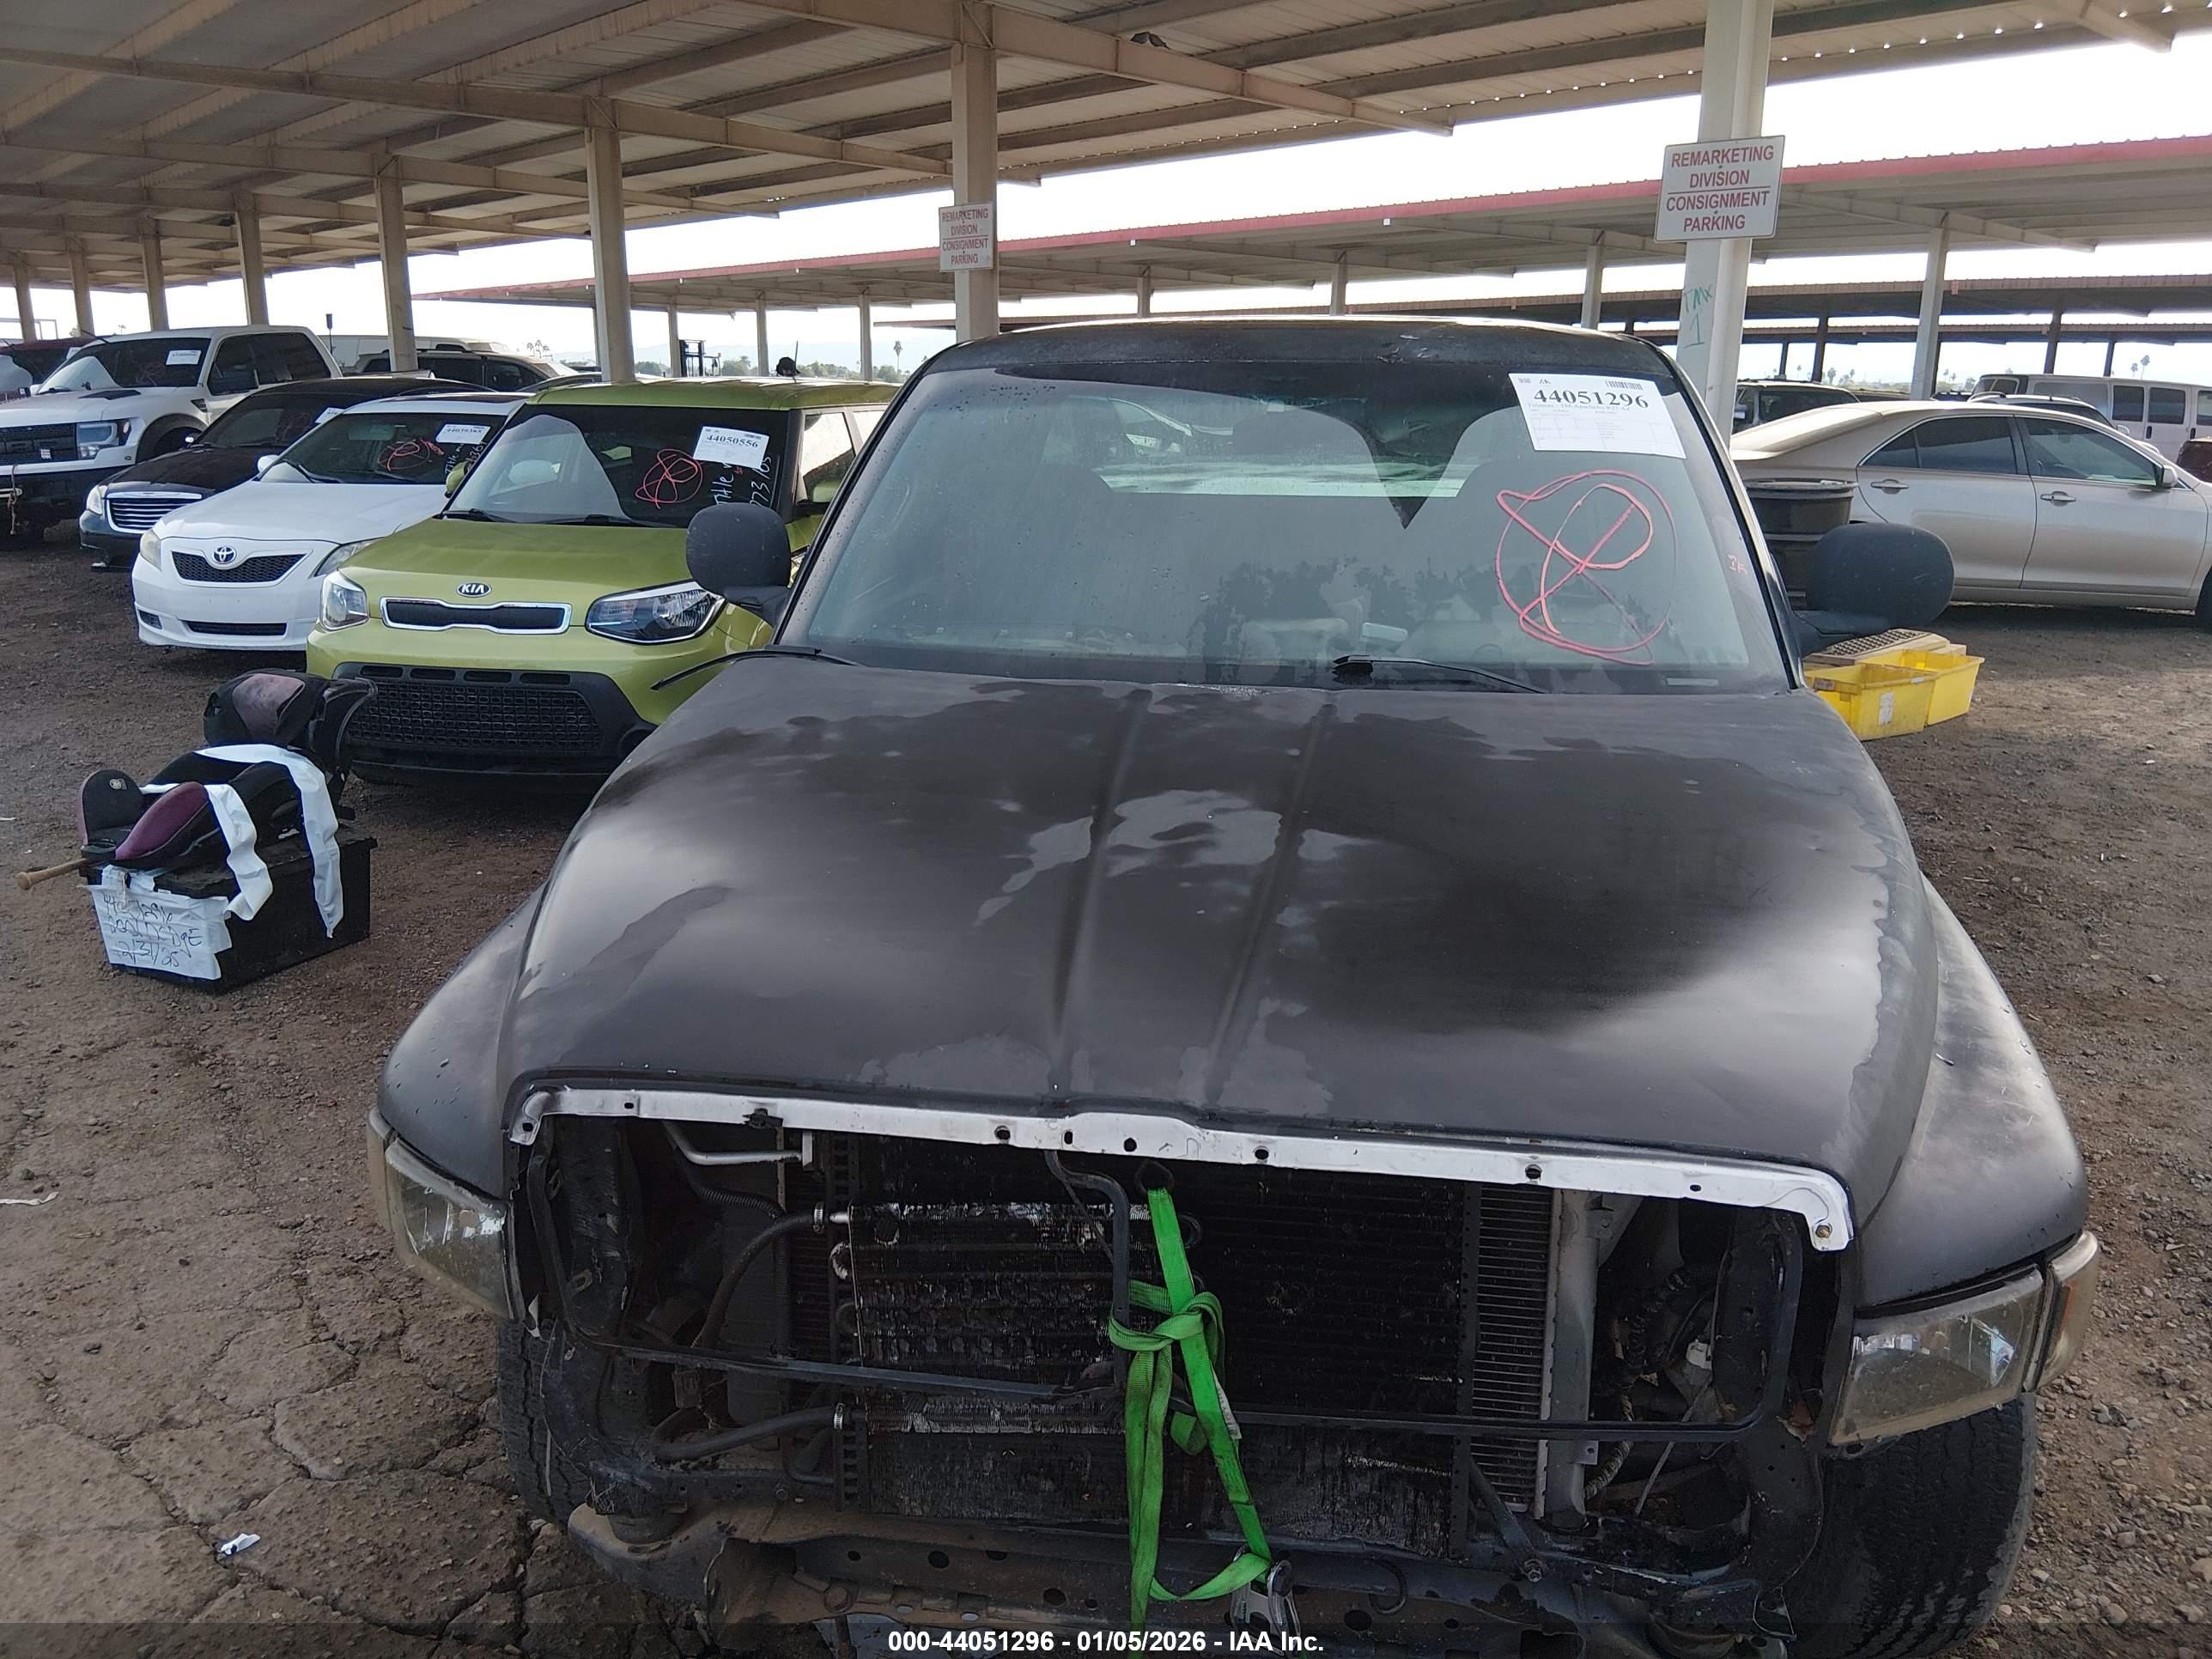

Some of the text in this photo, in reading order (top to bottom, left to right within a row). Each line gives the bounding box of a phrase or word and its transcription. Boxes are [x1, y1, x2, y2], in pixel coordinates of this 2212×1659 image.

[1671, 144, 1774, 167] REMARKETING
[1689, 169, 1750, 188] DIVISION
[1666, 191, 1771, 211] CONSIGNMENT
[942, 208, 988, 222] REMARKETING
[1683, 214, 1746, 232] PARKING
[951, 224, 978, 236] DIVISION
[942, 238, 989, 252] CONSIGNMENT
[951, 253, 979, 265] PARKING
[1534, 389, 1649, 409] 44051296
[461, 584, 485, 593] KIA
